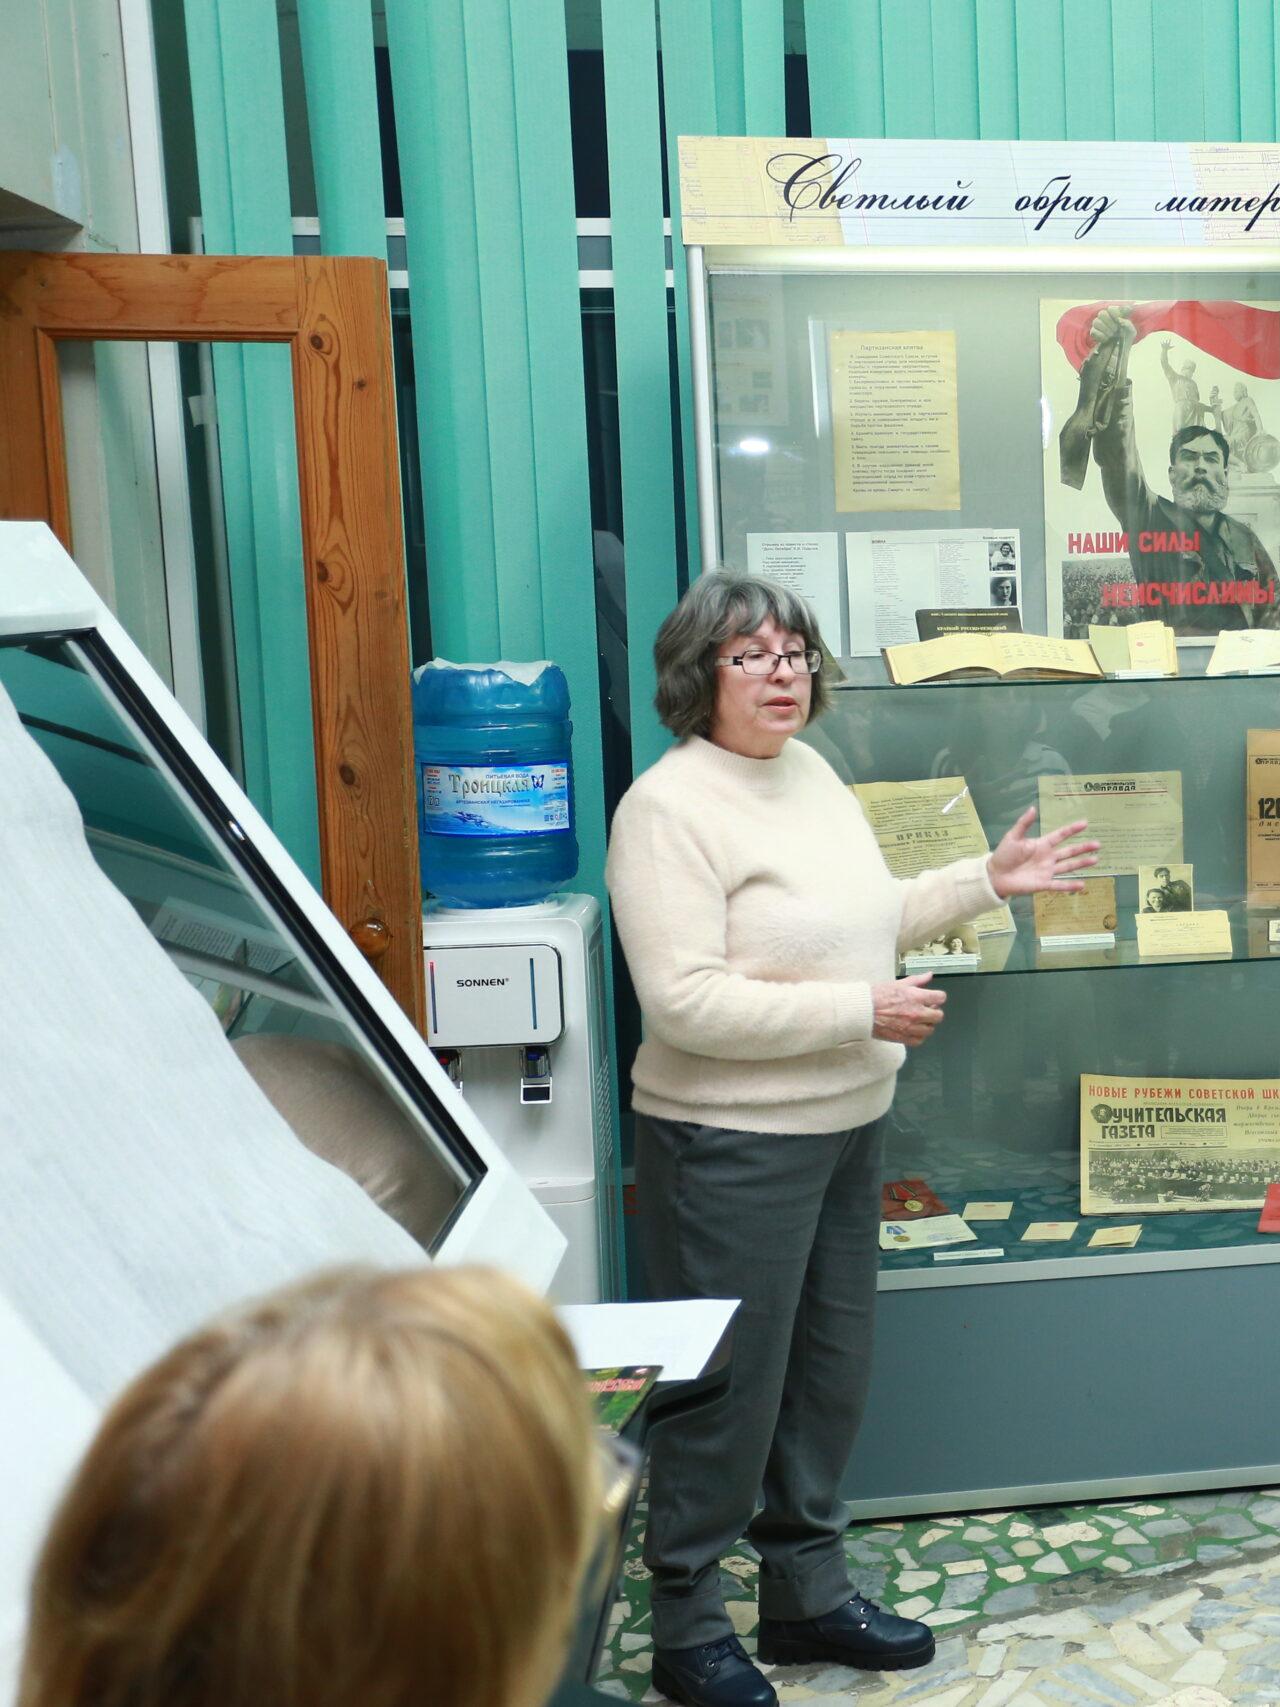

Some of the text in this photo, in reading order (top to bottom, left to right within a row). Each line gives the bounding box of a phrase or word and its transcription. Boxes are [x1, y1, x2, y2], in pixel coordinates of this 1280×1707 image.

[766, 152, 975, 222] Светлый
[1014, 174, 1118, 240] образ
[1068, 529, 1201, 554] НАШИ СИЛЫ
[1101, 580, 1276, 607] НЕИСЧИСЛИМЫ
[448, 774, 530, 799] Троицкая
[896, 829, 949, 842] ПРИКАЗ
[1088, 1085, 1128, 1099] НОВЫЕ
[1134, 1087, 1182, 1099] РУБЕЖИ
[1188, 1087, 1255, 1100] СОВЕТСКОЙ
[1111, 1107, 1227, 1123] УЧИТЕЛЬСКАЯ
[1101, 1124, 1156, 1139] ГАЗЕТА
